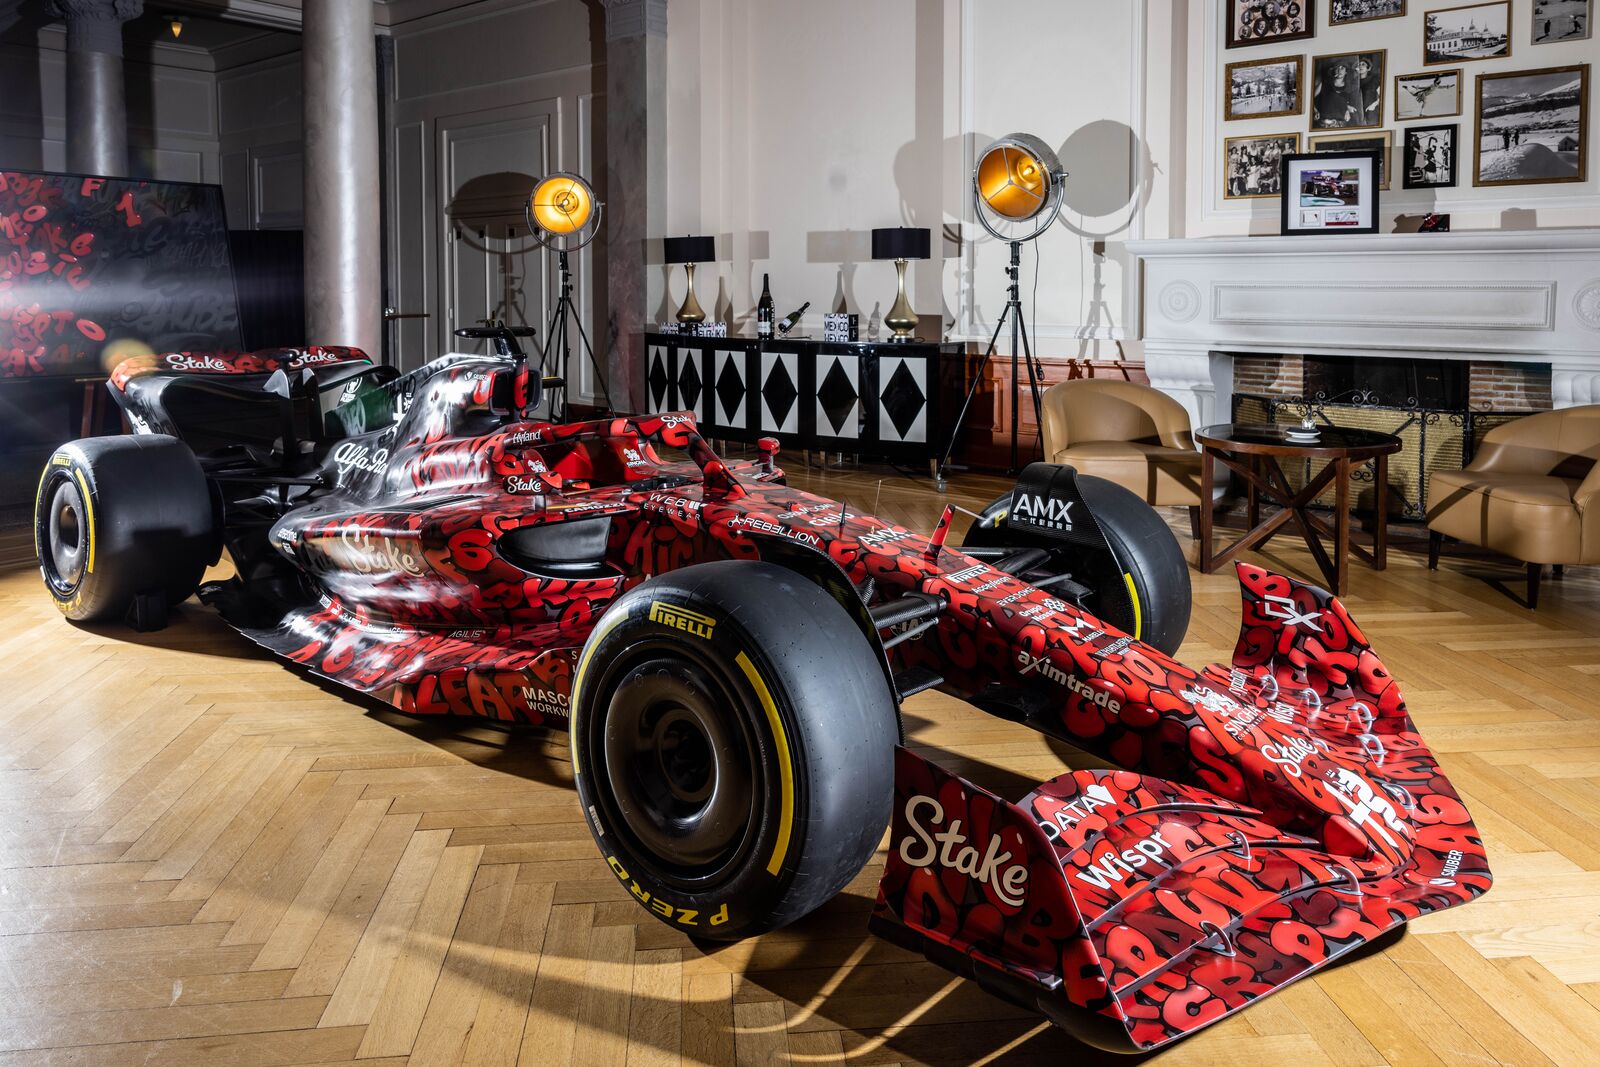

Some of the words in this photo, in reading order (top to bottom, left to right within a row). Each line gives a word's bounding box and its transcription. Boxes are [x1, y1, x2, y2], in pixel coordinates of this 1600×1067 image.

[166, 354, 227, 370] Stake
[288, 348, 338, 368] Stake
[512, 429, 542, 446] Hyland
[334, 442, 369, 474] Alfa
[507, 475, 542, 494] Stake
[643, 502, 702, 521] EYEWEAR
[648, 493, 688, 507] WEB
[1013, 493, 1075, 524] AMX
[341, 523, 426, 578] Stake
[944, 564, 992, 584] PIRELLI
[448, 629, 482, 638] AGILIS
[649, 601, 716, 640] PIRELLI
[1017, 650, 1122, 715] aximtrade
[522, 686, 571, 708] MASC
[526, 700, 569, 718] WORKW
[1223, 703, 1261, 737] SINGHA
[1261, 734, 1319, 778] Stake
[1039, 796, 1107, 840] DATA
[899, 795, 1029, 907] Stake
[1075, 831, 1173, 890] Wispr
[1441, 849, 1464, 877] SAUBER
[607, 855, 699, 926] ZERO
[709, 903, 730, 926] P
